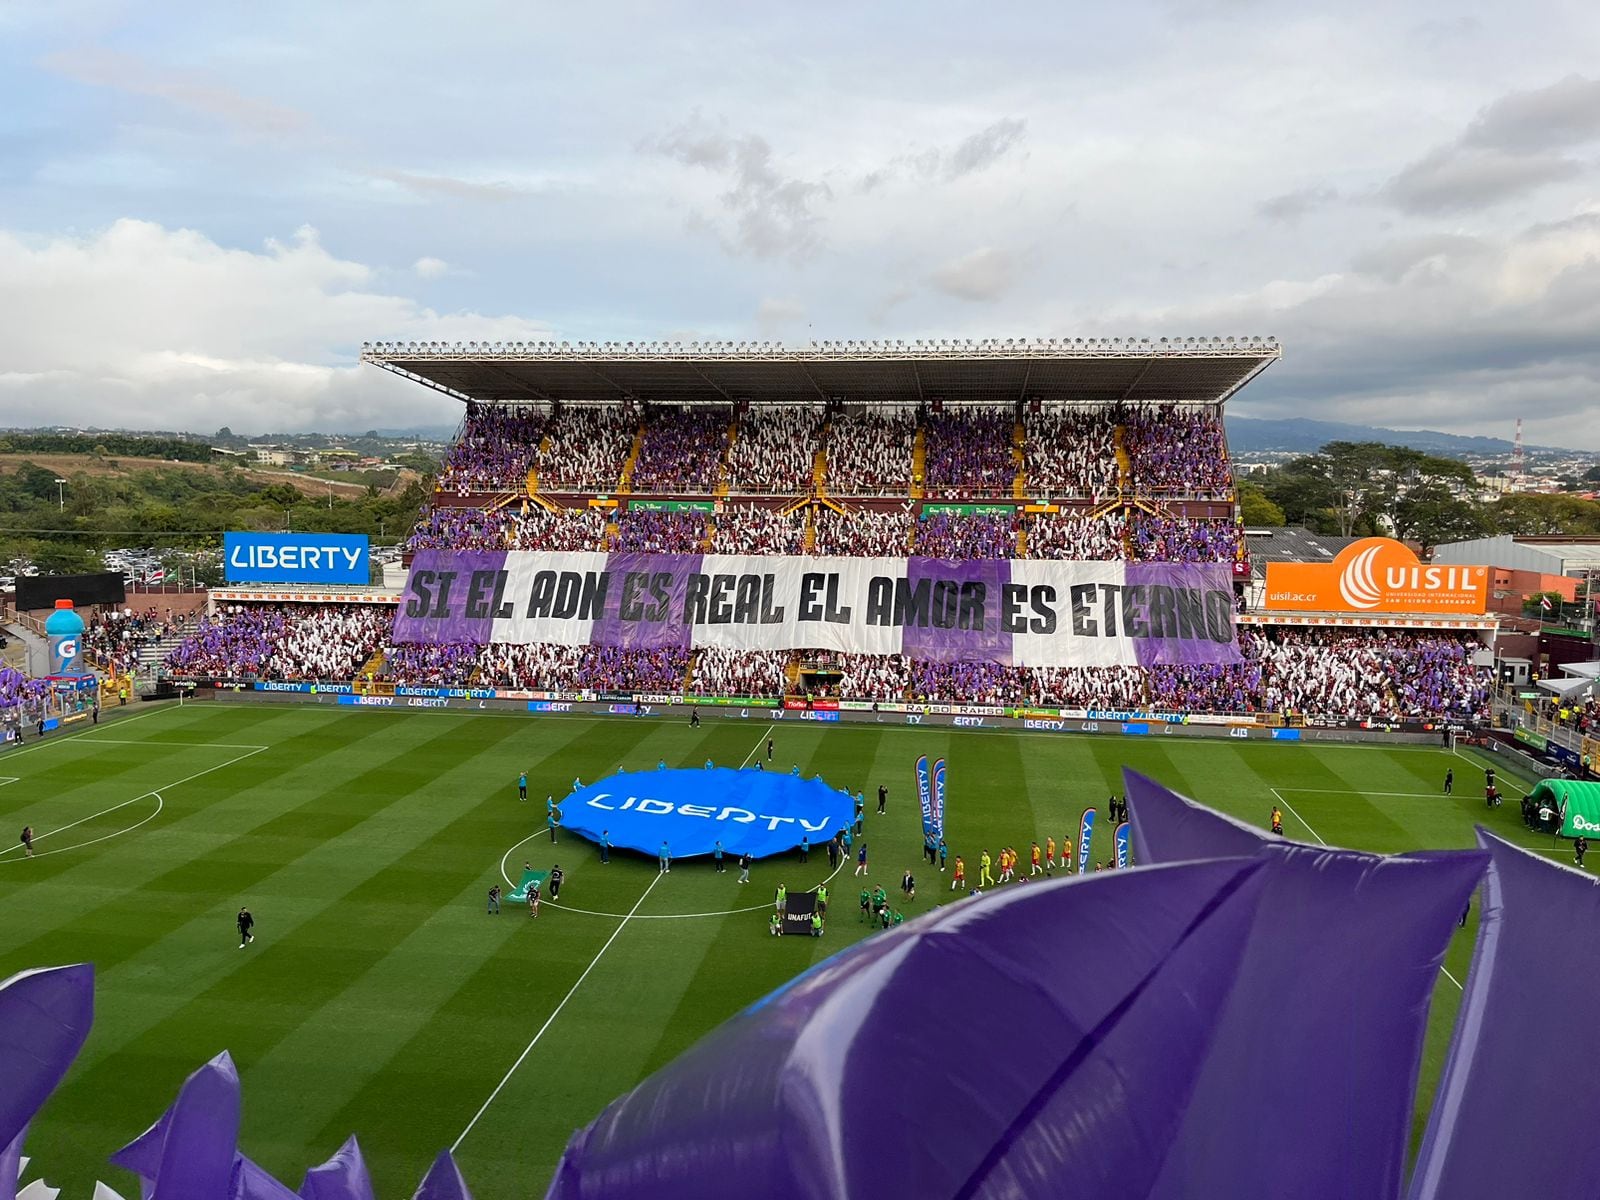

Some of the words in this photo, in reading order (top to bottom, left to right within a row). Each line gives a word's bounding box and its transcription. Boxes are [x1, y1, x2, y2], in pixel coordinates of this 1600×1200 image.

[230, 545, 362, 570] LIBERTY
[1386, 567, 1477, 590] UISIL
[1270, 592, 1317, 602] uisil.ac.cr
[405, 569, 457, 619] SI
[464, 570, 515, 619] EL
[526, 570, 610, 621] ADN
[619, 571, 673, 623] ES
[682, 572, 785, 625] REAL
[798, 572, 851, 625] EL
[866, 576, 987, 631] AMOR
[1001, 584, 1057, 635] ES
[1070, 582, 1234, 644] ETERNO
[58, 639, 76, 658] G
[264, 682, 302, 691] LIBERTY
[400, 687, 440, 696] LIBERTY
[1089, 711, 1135, 720] LIBERTY
[586, 793, 830, 832] LIBERTY
[787, 912, 812, 921] UNAFUT
